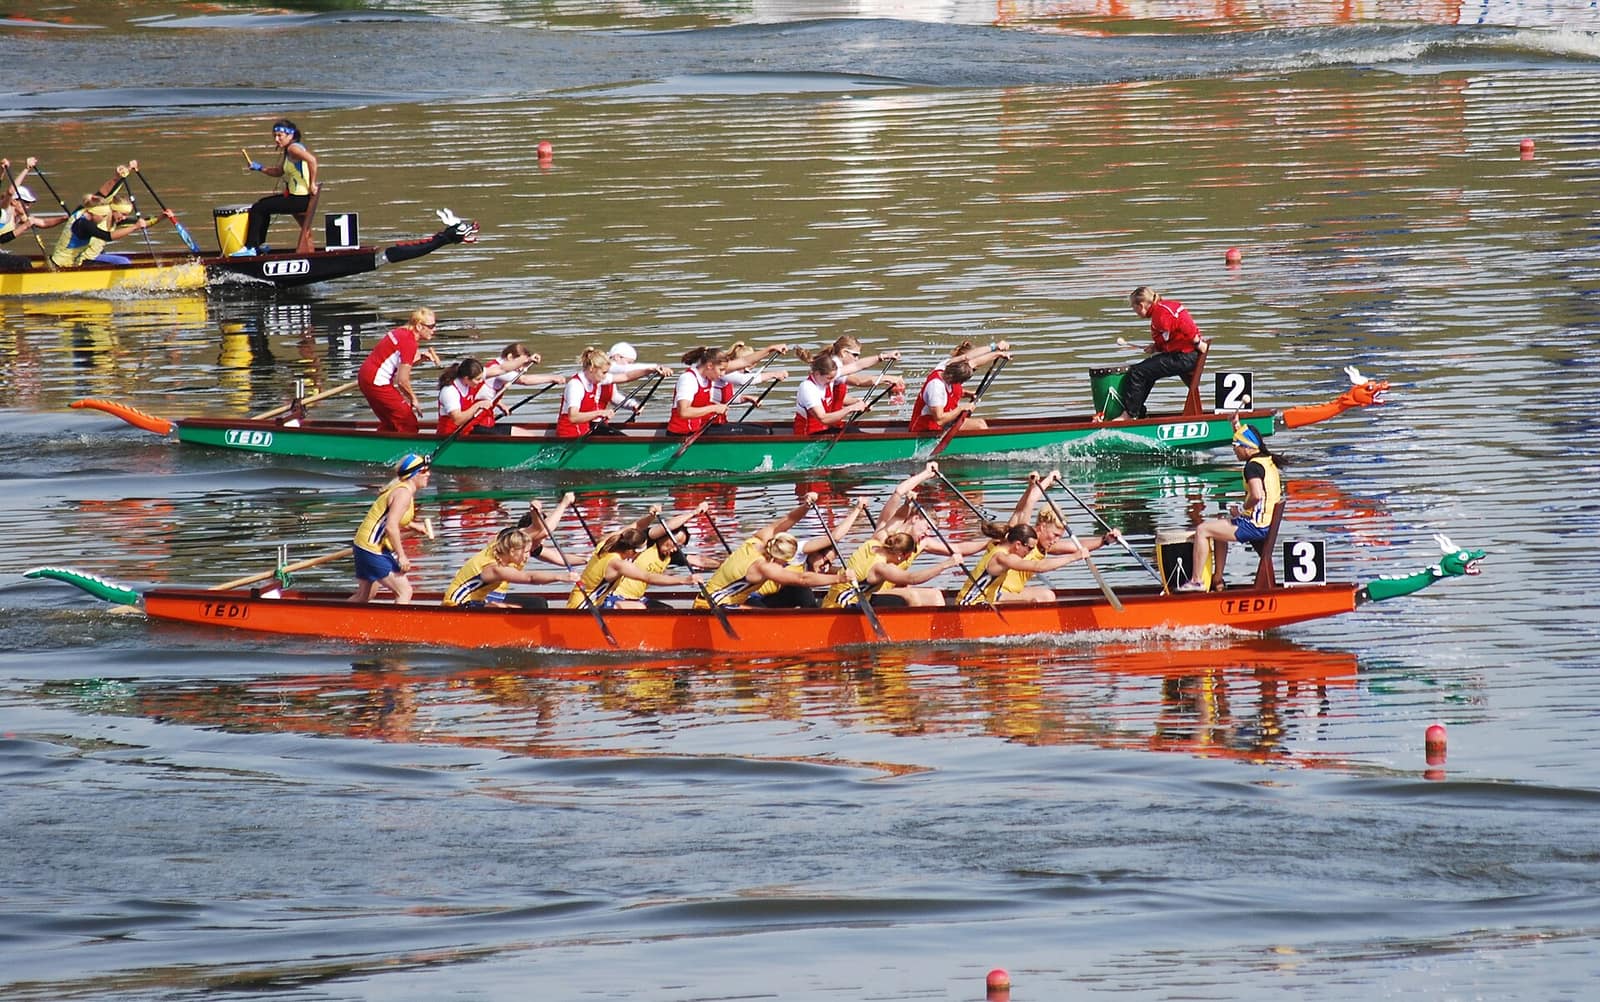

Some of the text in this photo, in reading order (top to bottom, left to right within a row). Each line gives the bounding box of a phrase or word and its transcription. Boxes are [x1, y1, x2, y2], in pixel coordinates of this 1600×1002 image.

[333, 214, 350, 247] 1
[265, 260, 308, 276] TEDI
[1223, 373, 1246, 409] 2
[229, 430, 271, 446] TEDI
[1161, 423, 1207, 439] TEDI
[1292, 541, 1317, 583] 3
[204, 602, 248, 618] TEDI
[1225, 598, 1274, 613] TEDI
